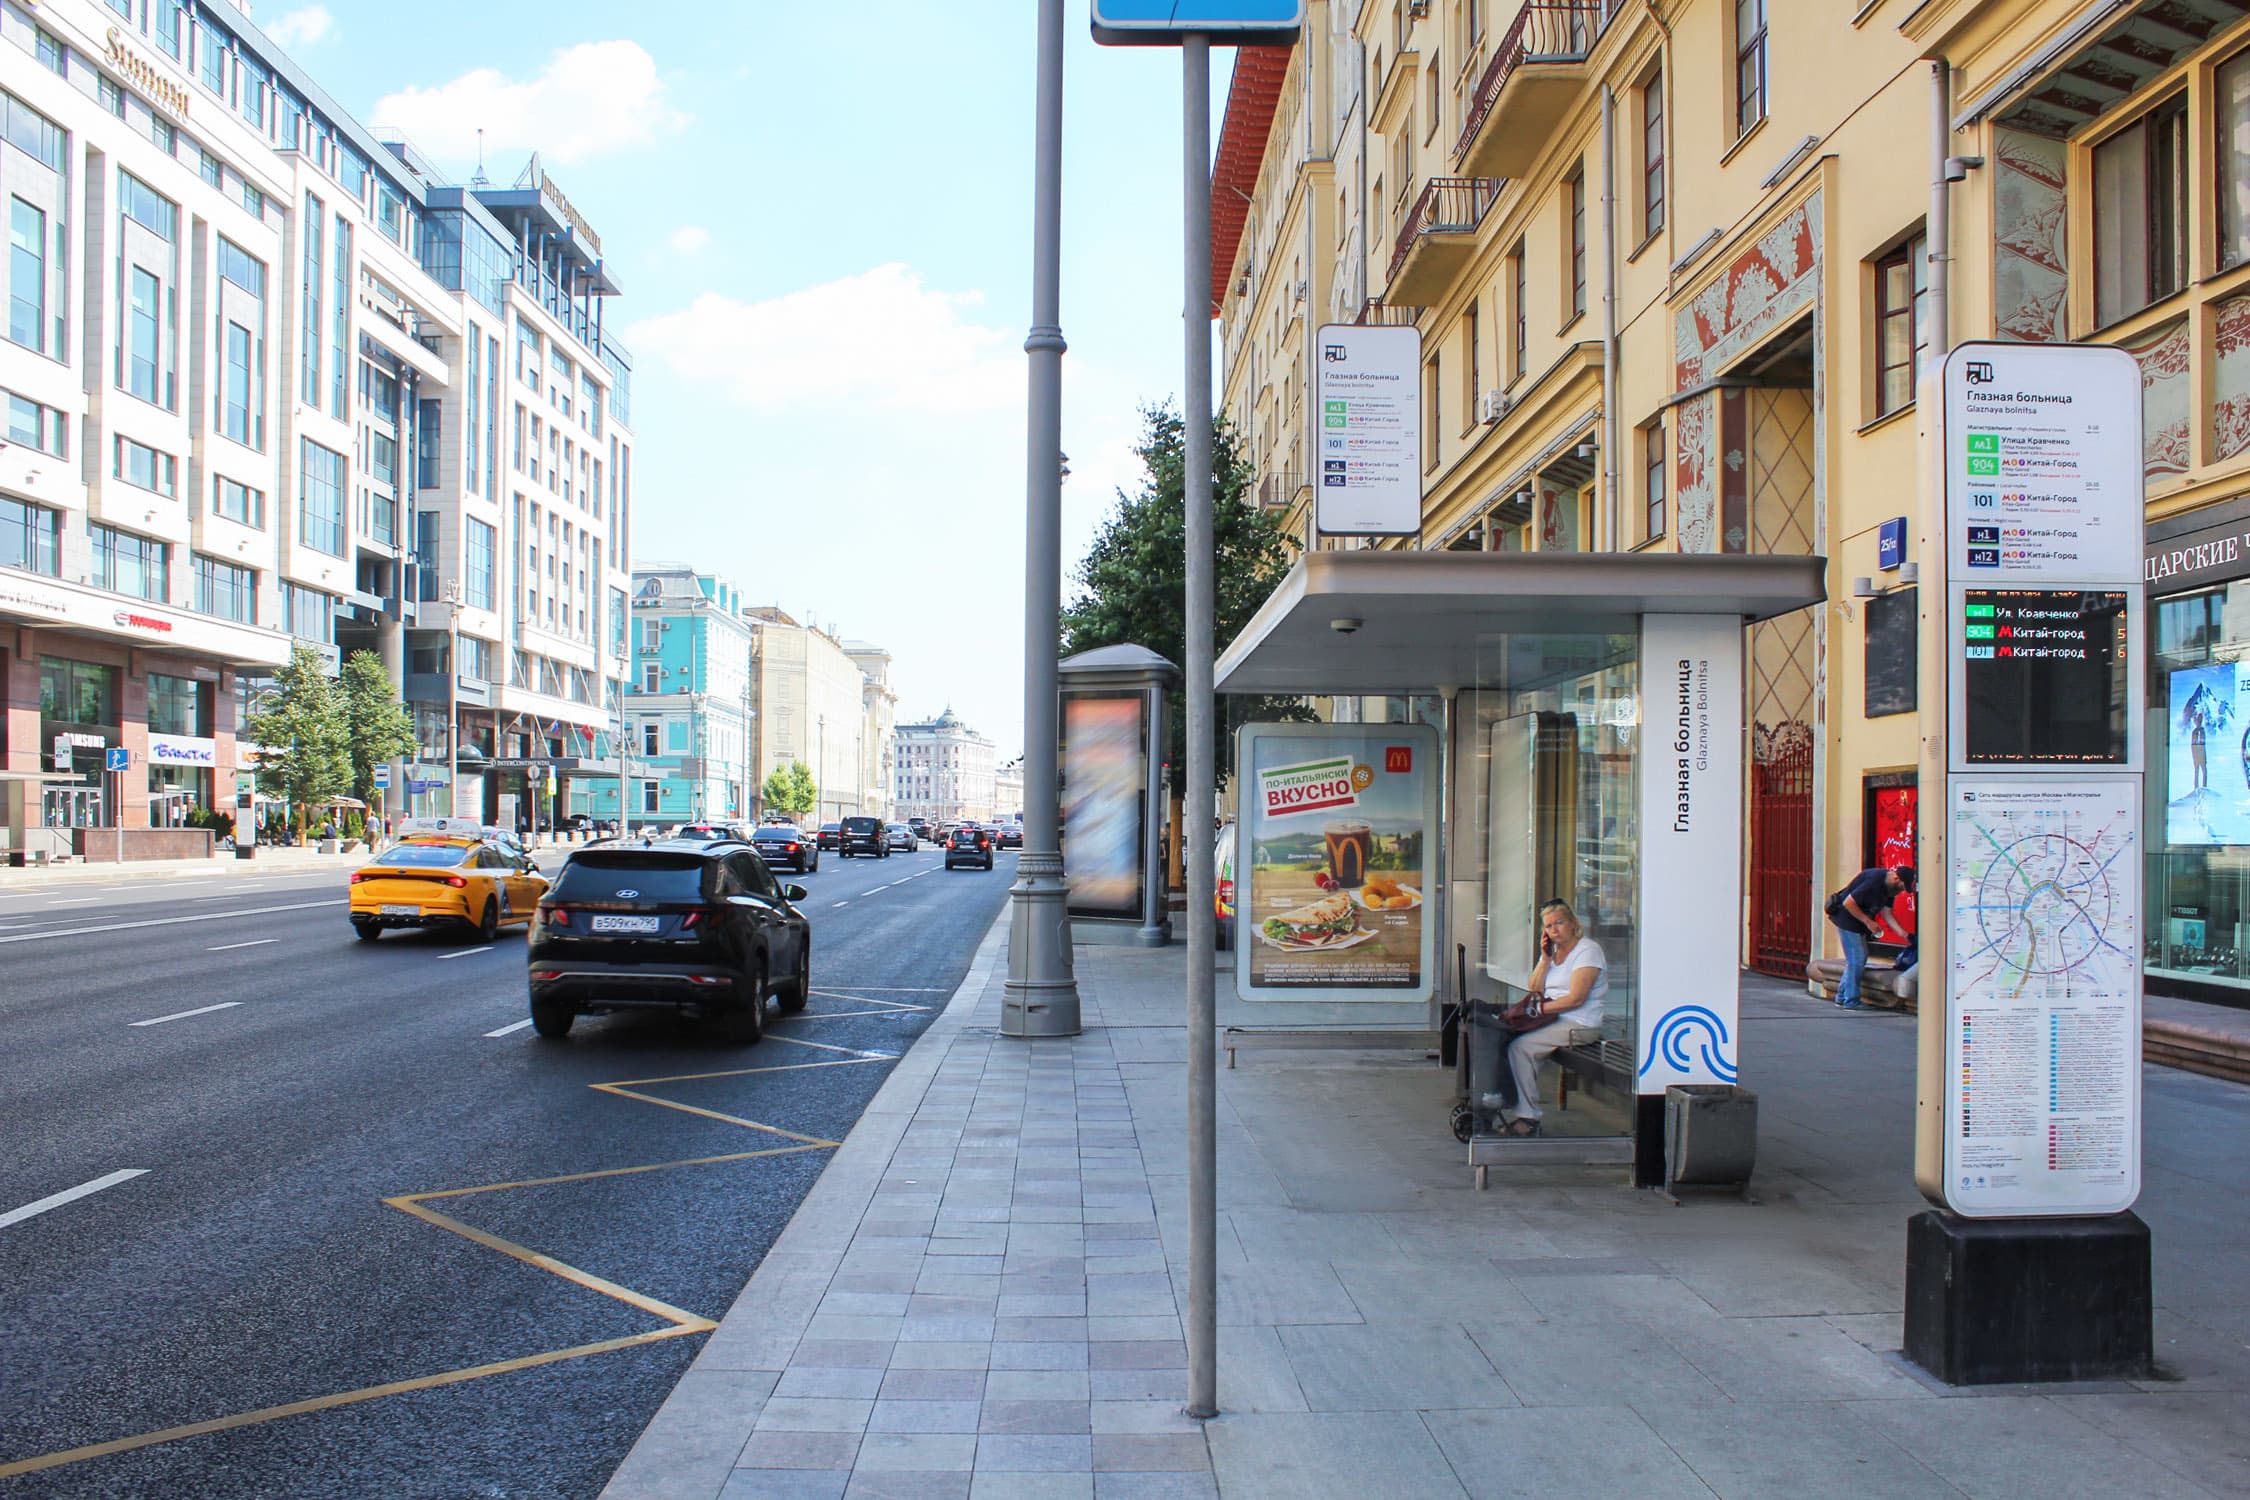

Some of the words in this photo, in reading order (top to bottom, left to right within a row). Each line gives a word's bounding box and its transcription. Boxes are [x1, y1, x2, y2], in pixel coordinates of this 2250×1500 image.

[1325, 371, 1358, 380] Глазная
[1359, 372, 1400, 381] больница
[1967, 390, 2013, 402] Глазная
[2016, 391, 2073, 404] больница
[1966, 404, 2003, 414] Glaznaya
[2005, 405, 2037, 414] bolnitsa
[1329, 440, 1342, 448] 101
[1974, 437, 1993, 449] м1
[2001, 436, 2026, 445] Улица
[2027, 436, 2070, 445] Кравченко
[1972, 458, 1994, 470] 904
[2026, 459, 2077, 468] Китай-Город
[1973, 494, 1993, 507] 101
[2027, 493, 2077, 503] Китай-Город
[1977, 529, 1989, 539] н1
[2027, 528, 2077, 538] Китай-Город
[1975, 551, 1993, 561] н12
[2027, 551, 2077, 560] Китай-Город
[2144, 536, 2238, 584] ЦАРСКИЕ
[2018, 607, 2079, 619] Кравченко
[2117, 610, 2126, 619] 4
[1966, 626, 1990, 637] 904
[2013, 625, 2086, 640] Китай-город
[2117, 628, 2126, 639] 5
[1971, 646, 1988, 657] 101
[2013, 646, 2086, 659] Китай-город
[2117, 647, 2126, 658] 6
[1696, 659, 1708, 710] Bolnitsa
[1674, 659, 1692, 753] больница
[1696, 713, 1710, 771] Glaznaya
[1266, 769, 1348, 789] ПО-ИТАЛЬЯНСКИ
[1267, 779, 1350, 806] ВКУСНО
[1674, 758, 1690, 833] Глазная
